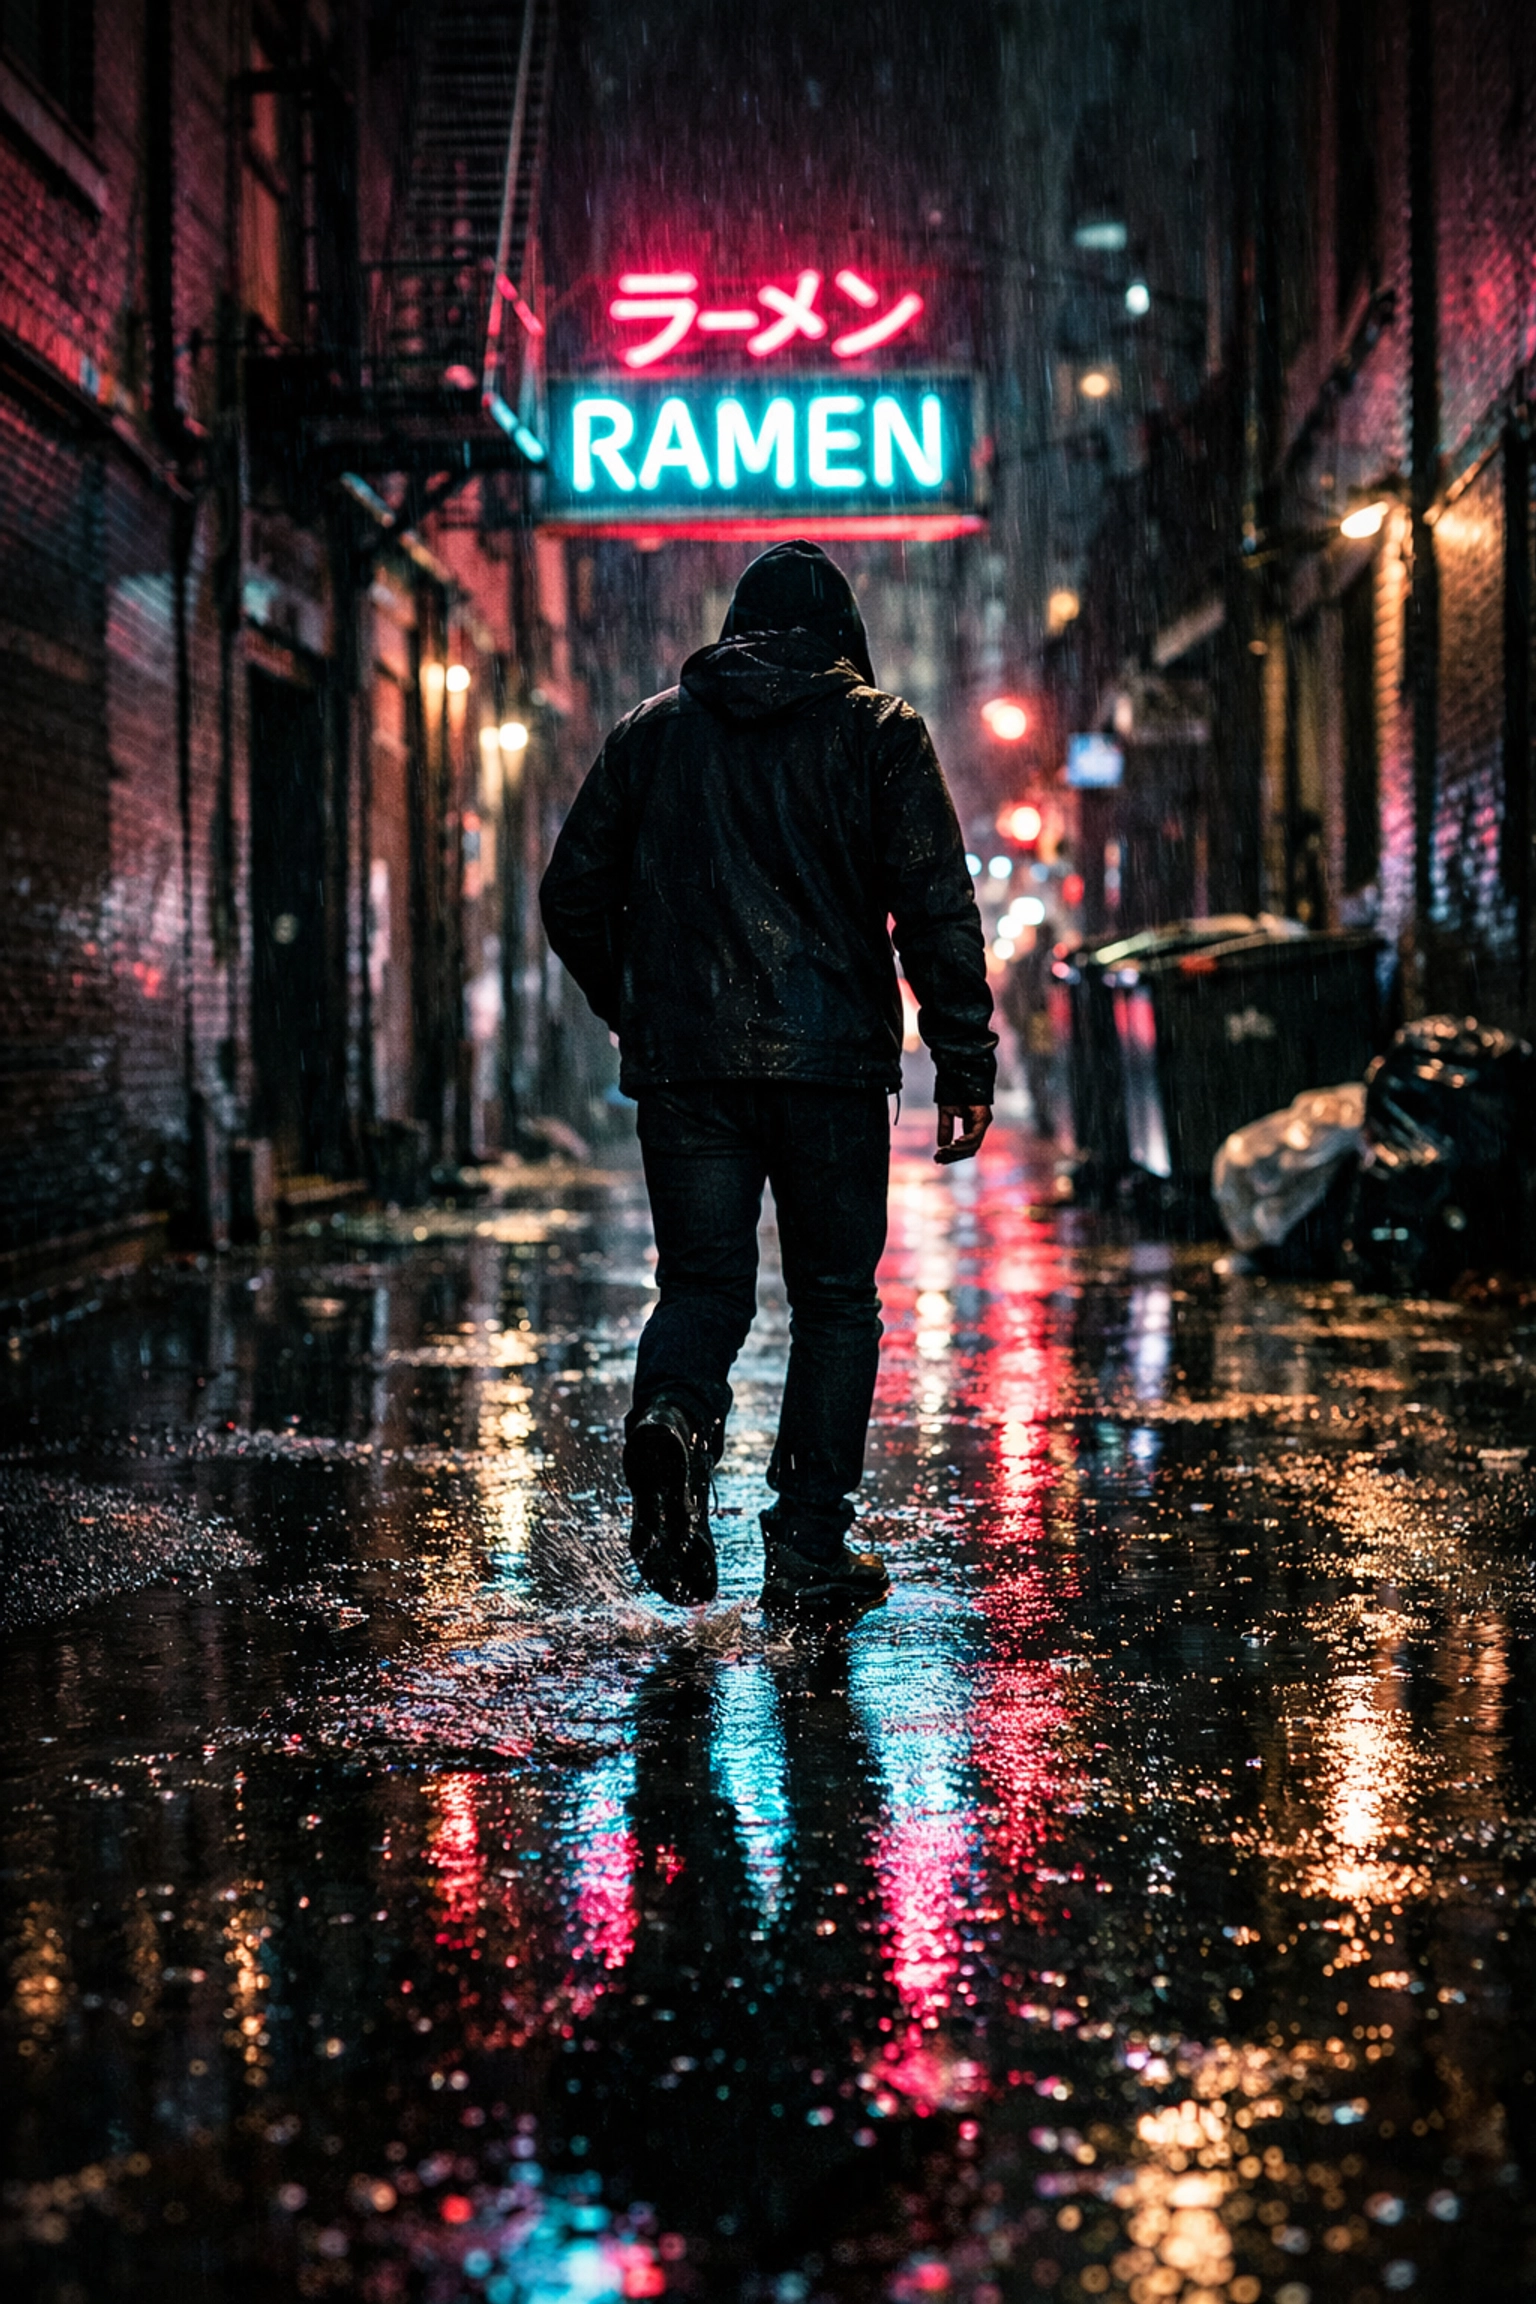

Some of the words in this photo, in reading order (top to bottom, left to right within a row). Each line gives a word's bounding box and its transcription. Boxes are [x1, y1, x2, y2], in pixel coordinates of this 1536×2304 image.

[609, 269, 924, 369] ラーメン
[571, 393, 943, 492] RAMEN
